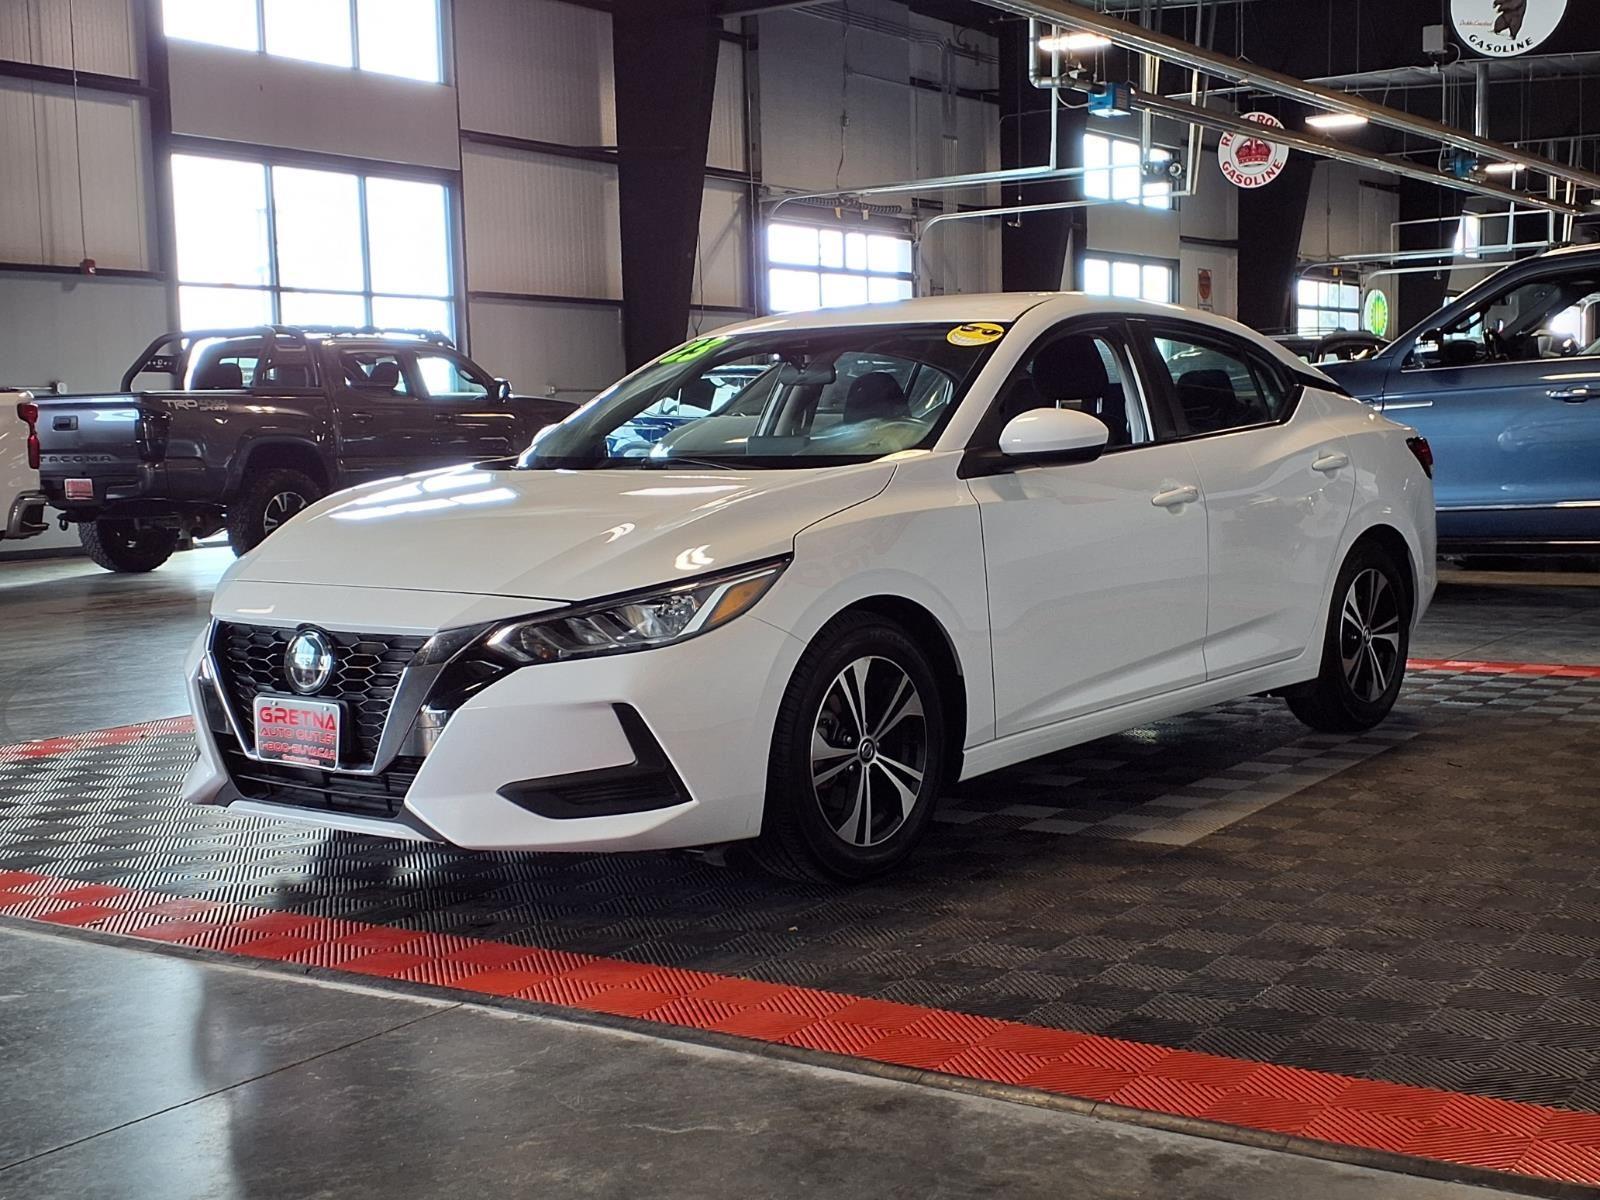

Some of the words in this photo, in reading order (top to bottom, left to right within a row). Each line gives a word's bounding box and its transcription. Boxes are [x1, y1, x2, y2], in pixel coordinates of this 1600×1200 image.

[1468, 34, 1533, 53] GASOLINE
[1247, 114, 1280, 127] CRO
[1222, 159, 1283, 186] GASOLINE
[259, 706, 336, 730] GRETNA
[259, 727, 293, 739] AUTO
[295, 729, 336, 745] OUTLET
